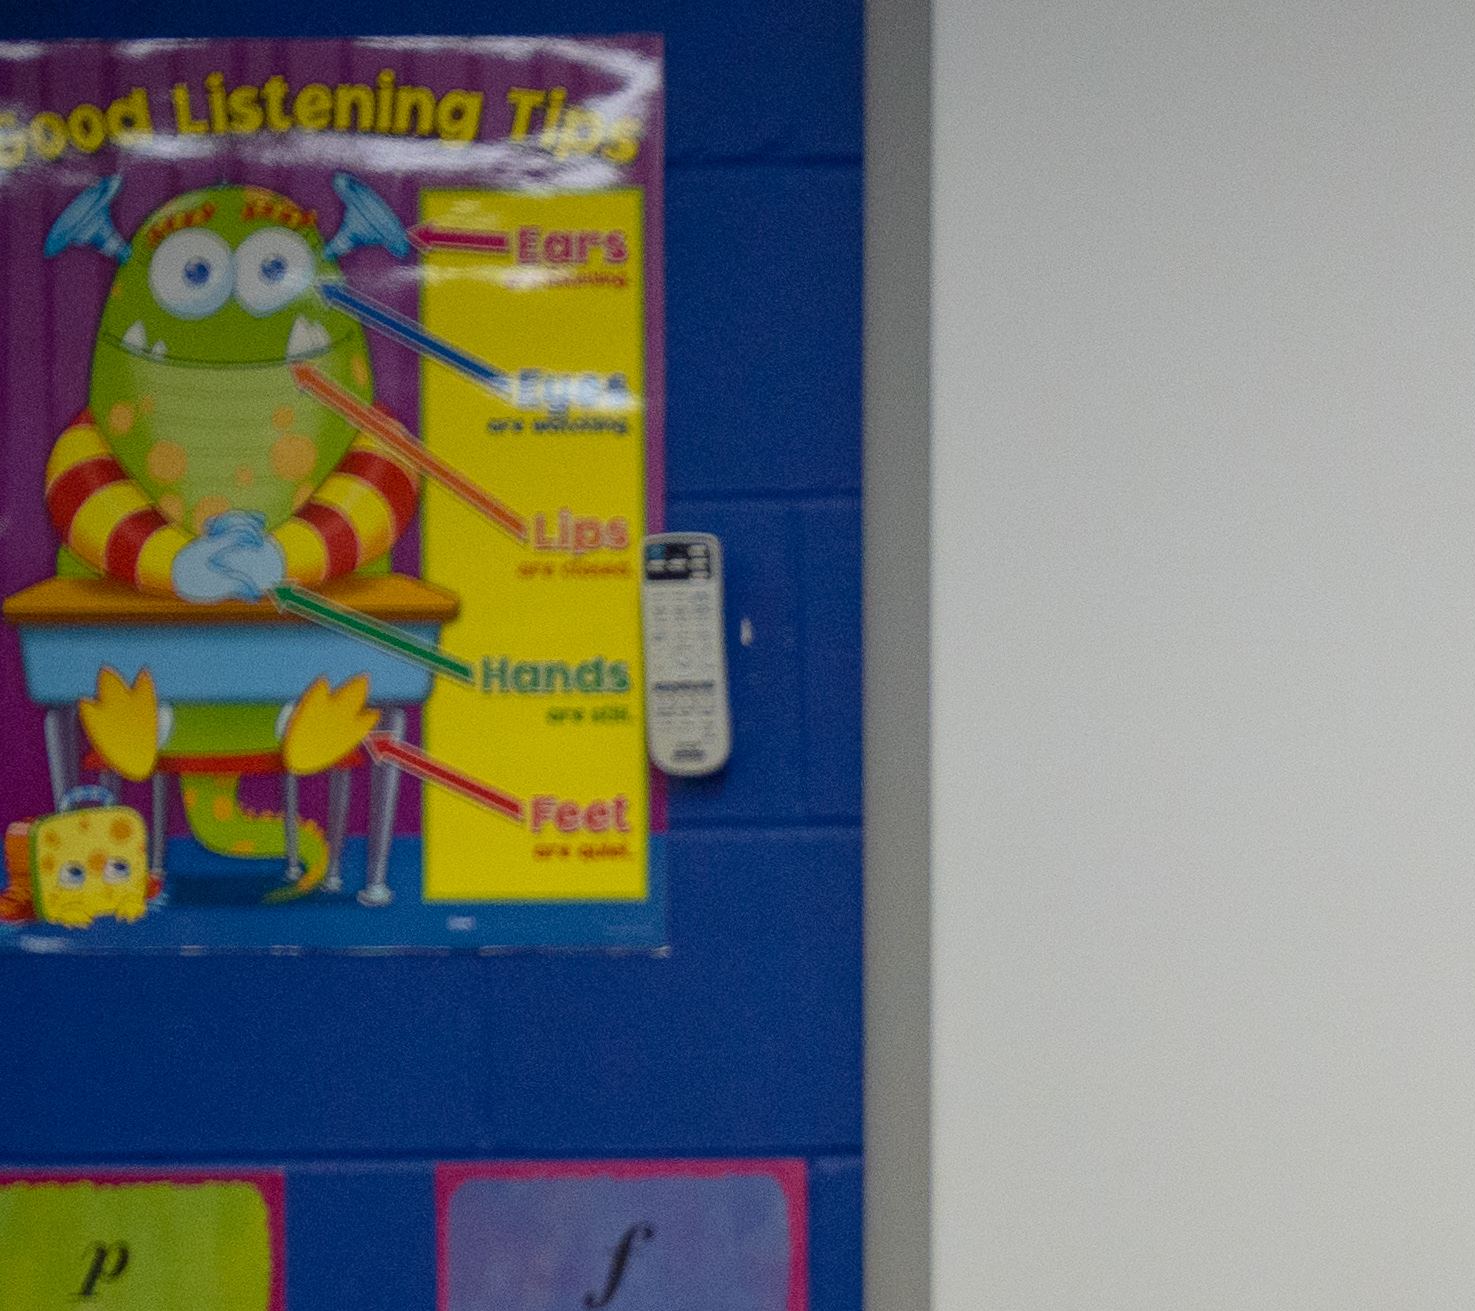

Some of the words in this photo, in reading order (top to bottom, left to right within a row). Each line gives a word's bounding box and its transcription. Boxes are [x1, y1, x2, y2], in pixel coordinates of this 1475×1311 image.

[173, 69, 483, 148] Listening
[506, 87, 642, 164] Tips
[516, 227, 627, 266] Ears
[517, 369, 628, 417] Eyes
[532, 508, 630, 555] Lips
[481, 656, 630, 694] Hands
[530, 795, 631, 836] Feet
